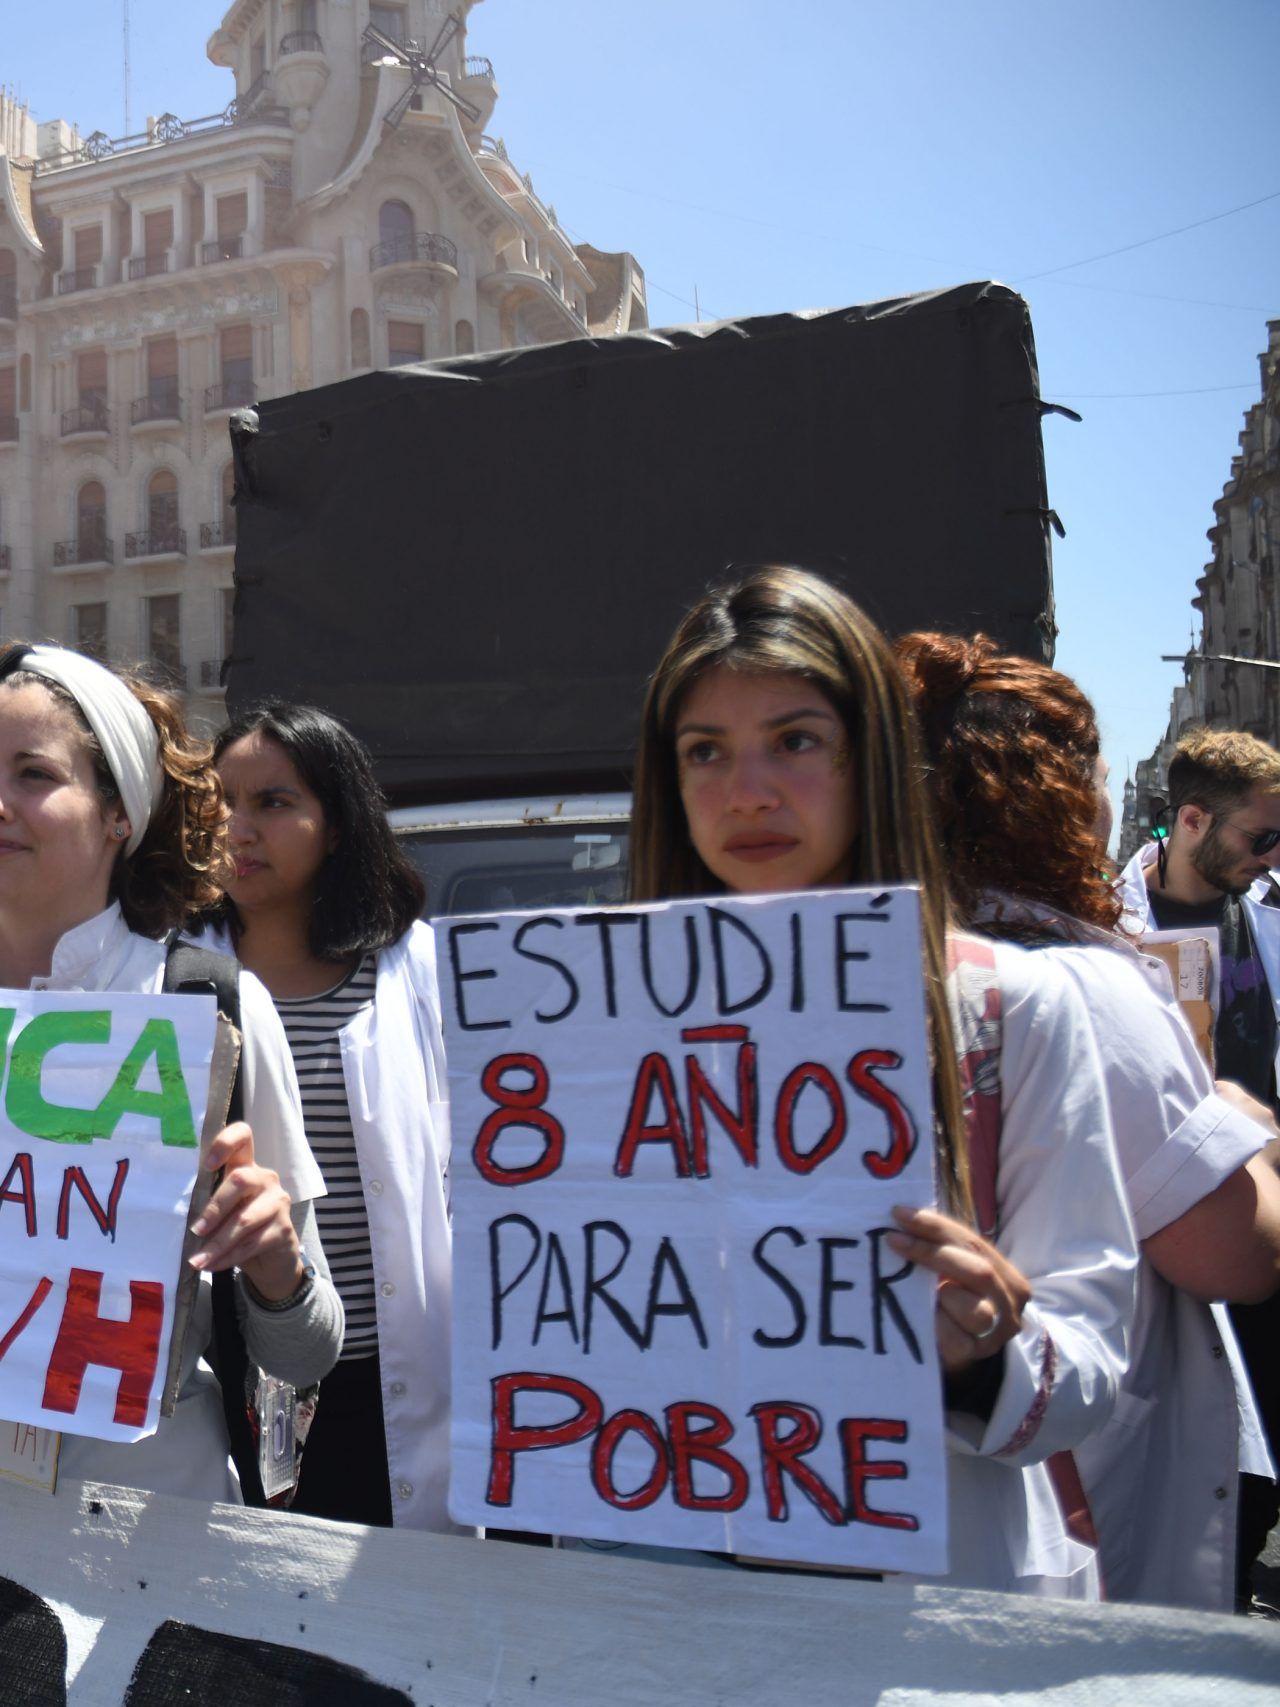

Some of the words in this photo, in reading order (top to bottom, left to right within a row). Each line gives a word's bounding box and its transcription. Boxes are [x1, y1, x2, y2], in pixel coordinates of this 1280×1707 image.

[447, 893, 892, 1031] ESTUDIÉ
[473, 1053, 565, 1186] 8
[613, 1023, 918, 1179] AÑOS
[488, 1213, 710, 1354] PARA
[752, 1225, 925, 1364] SER
[486, 1372, 920, 1532] POBRE
